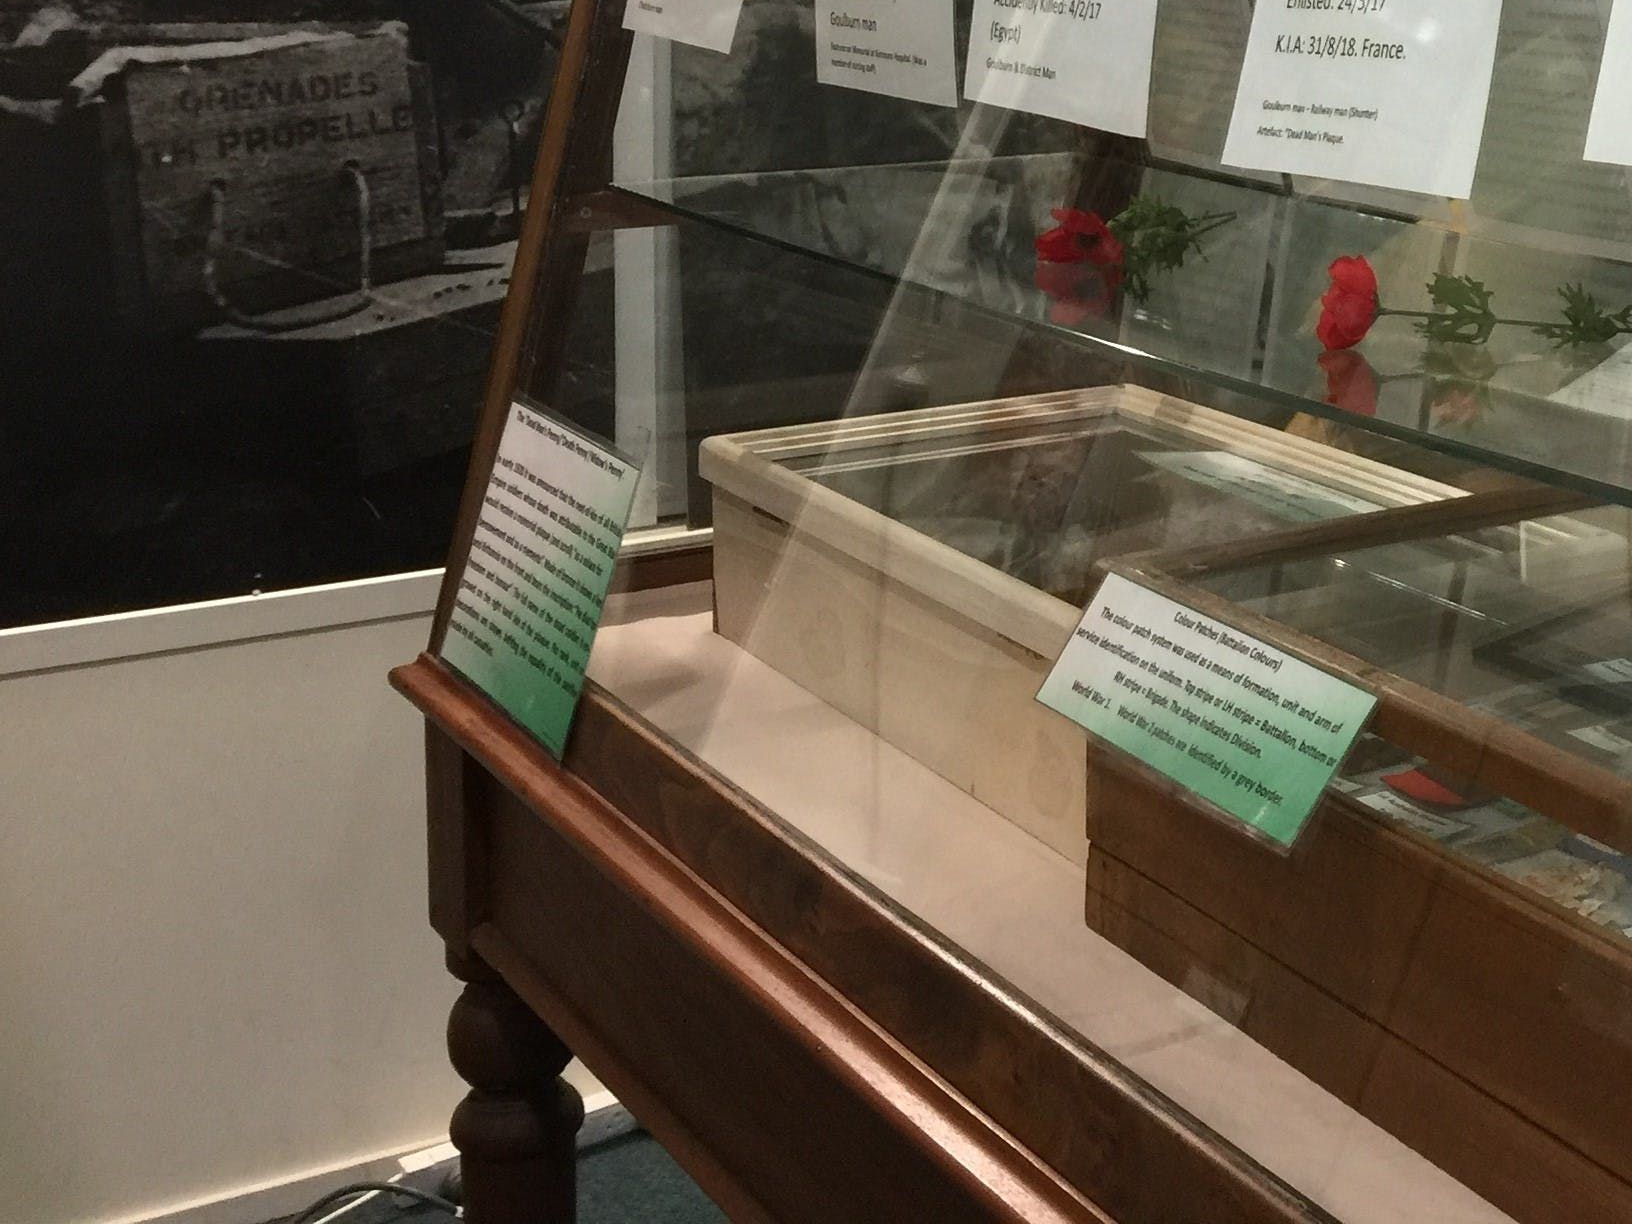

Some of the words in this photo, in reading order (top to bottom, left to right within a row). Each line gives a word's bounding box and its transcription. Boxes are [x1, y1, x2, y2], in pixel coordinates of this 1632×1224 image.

[991, 21, 1021, 44] (Egypt)
[1275, 35, 1304, 54] K.I.A:
[1362, 39, 1406, 60] France.
[1174, 611, 1196, 629] Colour
[1250, 647, 1283, 673] Colours)
